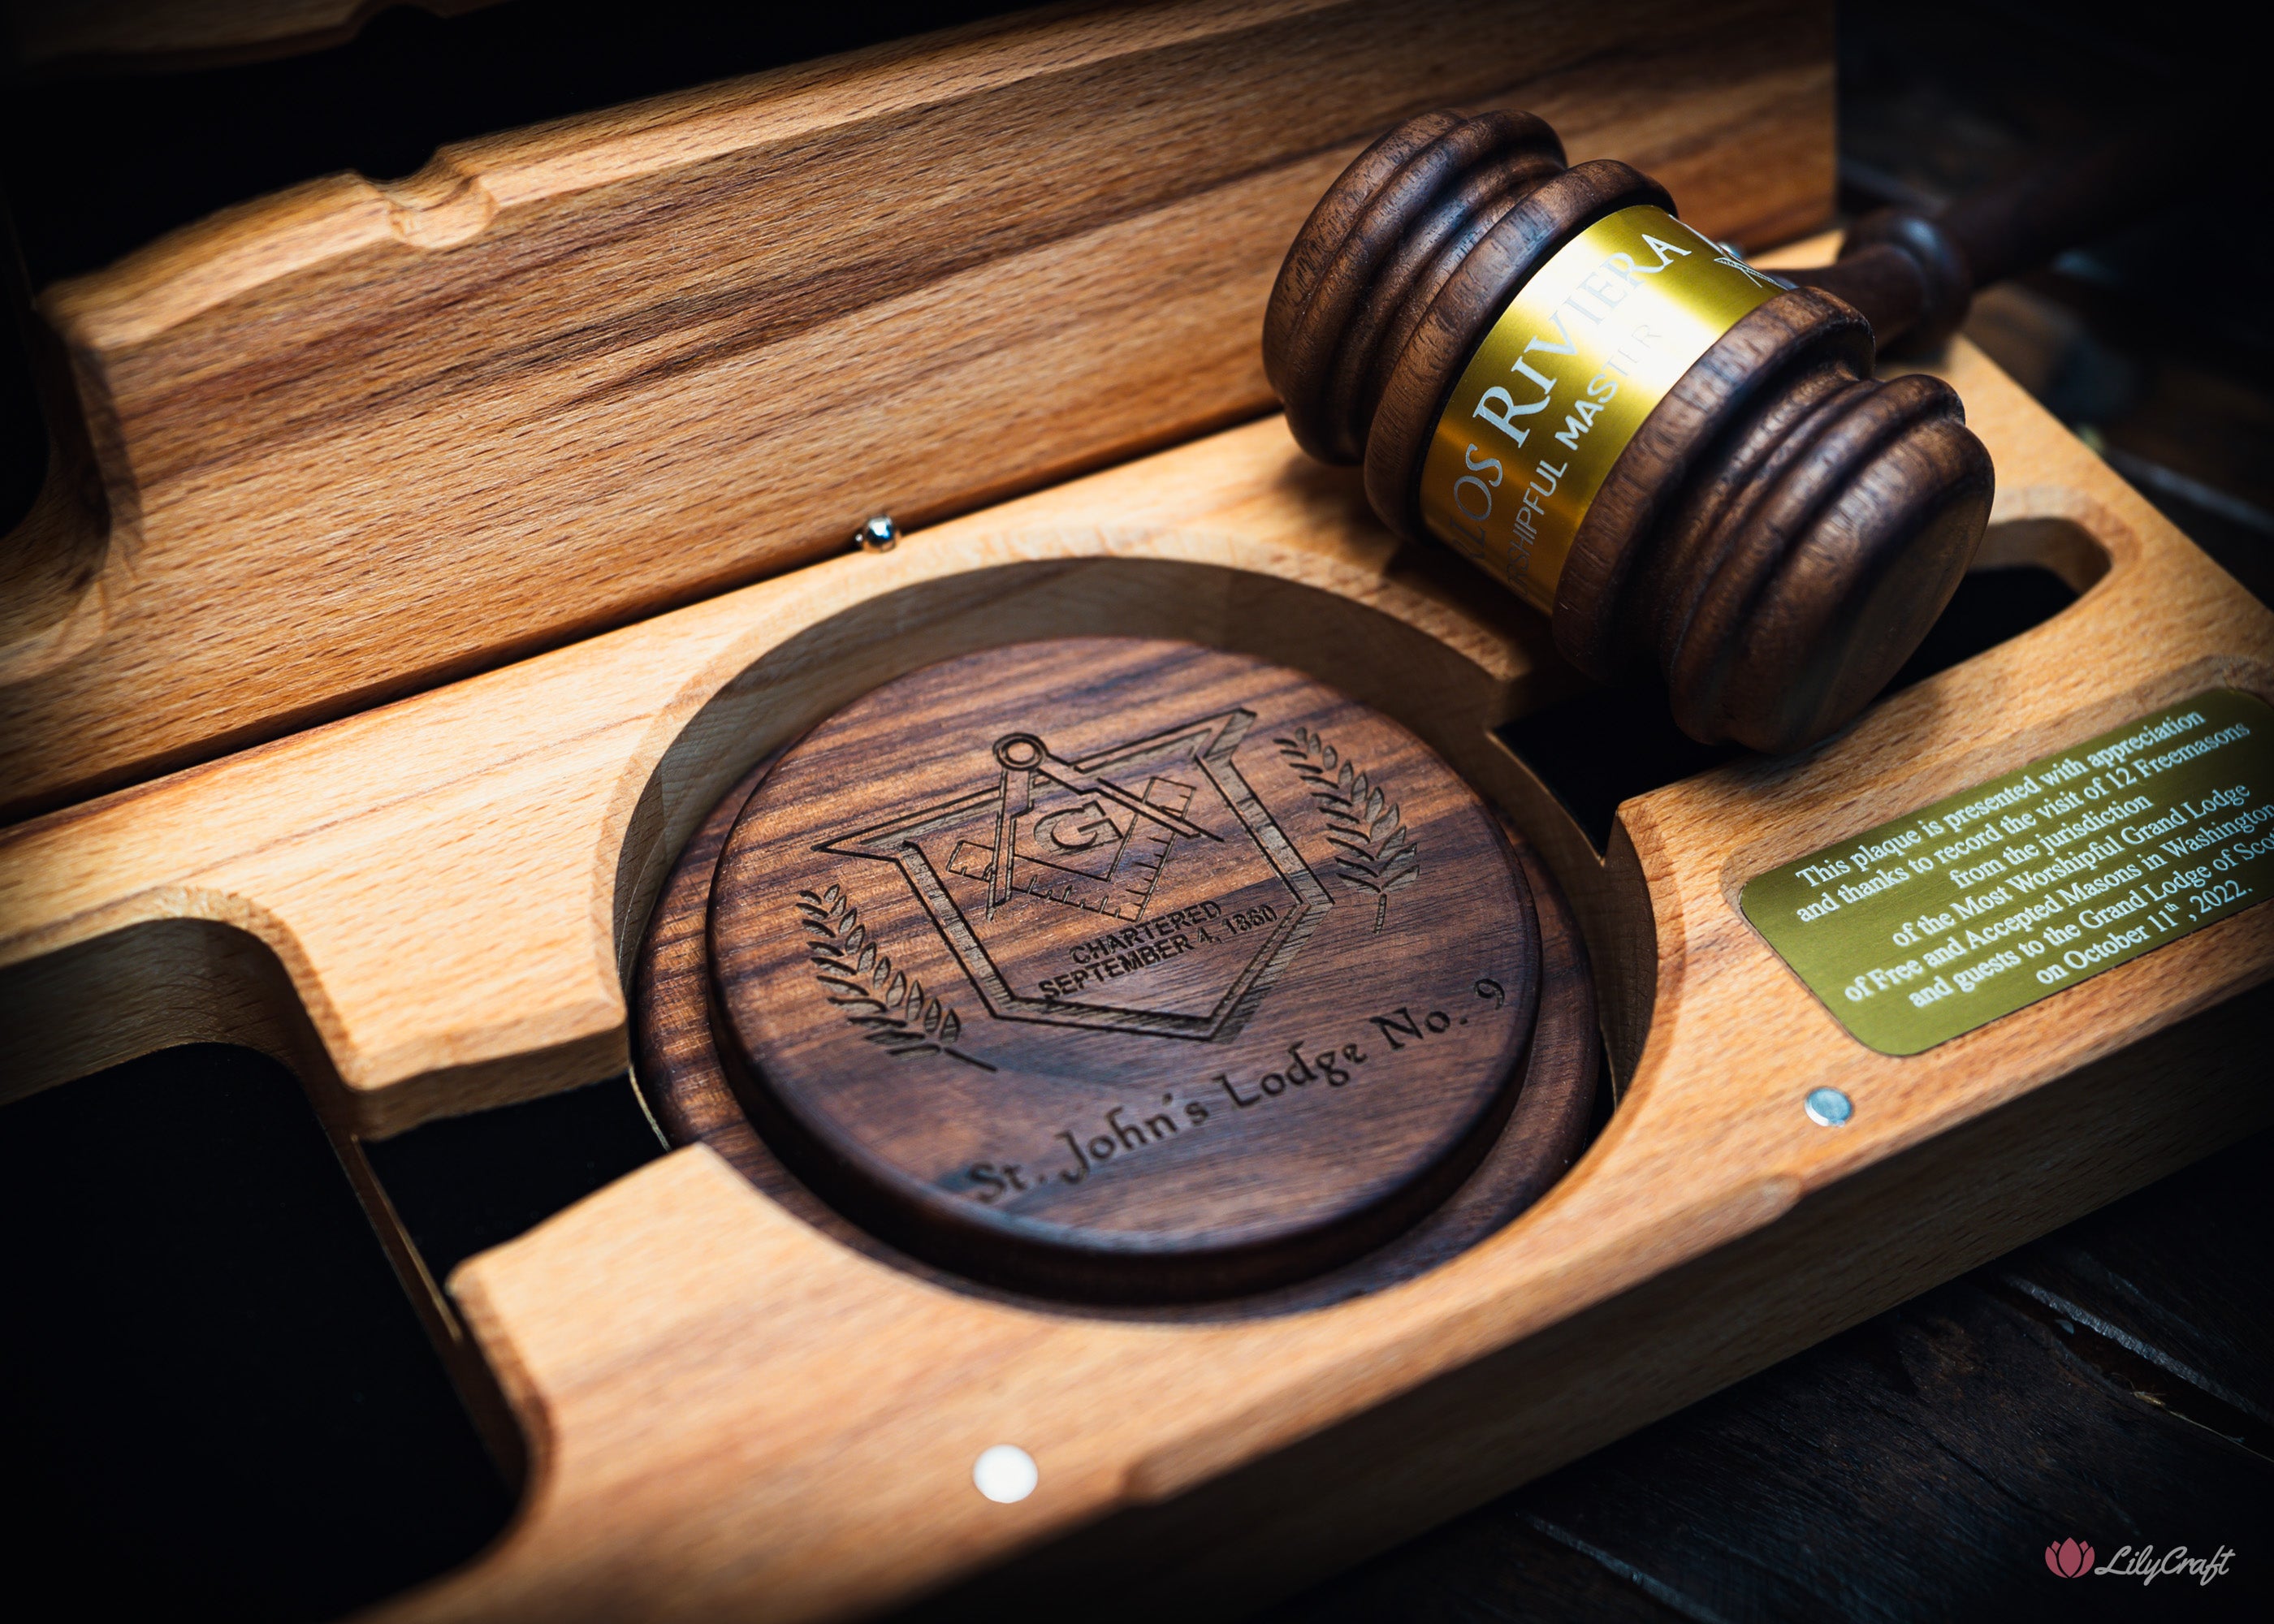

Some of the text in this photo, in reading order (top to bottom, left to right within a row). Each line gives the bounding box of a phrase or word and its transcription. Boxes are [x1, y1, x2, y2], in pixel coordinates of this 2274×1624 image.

[1472, 233, 1692, 447] RIVIERA
[1554, 325, 1662, 450] MASTER
[1033, 800, 1123, 853] G
[1795, 710, 2206, 887] This plaque is presented with appreciation
[1796, 723, 2250, 922] and thanks to record the visit of 12 Freemasons
[1892, 785, 2250, 947] of the Most Worshipful Grand Lodge
[1950, 793, 2154, 889] from the jurisdiction
[1038, 903, 1279, 1000] SEPTEMBER 4, 1860
[1069, 900, 1221, 965] CHARTERED
[1844, 803, 2274, 1002] of Free and Accepted Masons in Washington
[1909, 976, 1954, 1008] and
[1952, 949, 2021, 992] guests
[2018, 939, 2045, 957] to
[2043, 923, 2081, 947] the
[2078, 890, 2148, 928] Grand
[2141, 866, 2211, 901] Lodge
[2213, 849, 2238, 871] of
[2036, 964, 2069, 984] on
[2064, 925, 2151, 970] October
[2190, 879, 2253, 914] 2022.
[971, 978, 1507, 1205] St. John's Lodge No. 9
